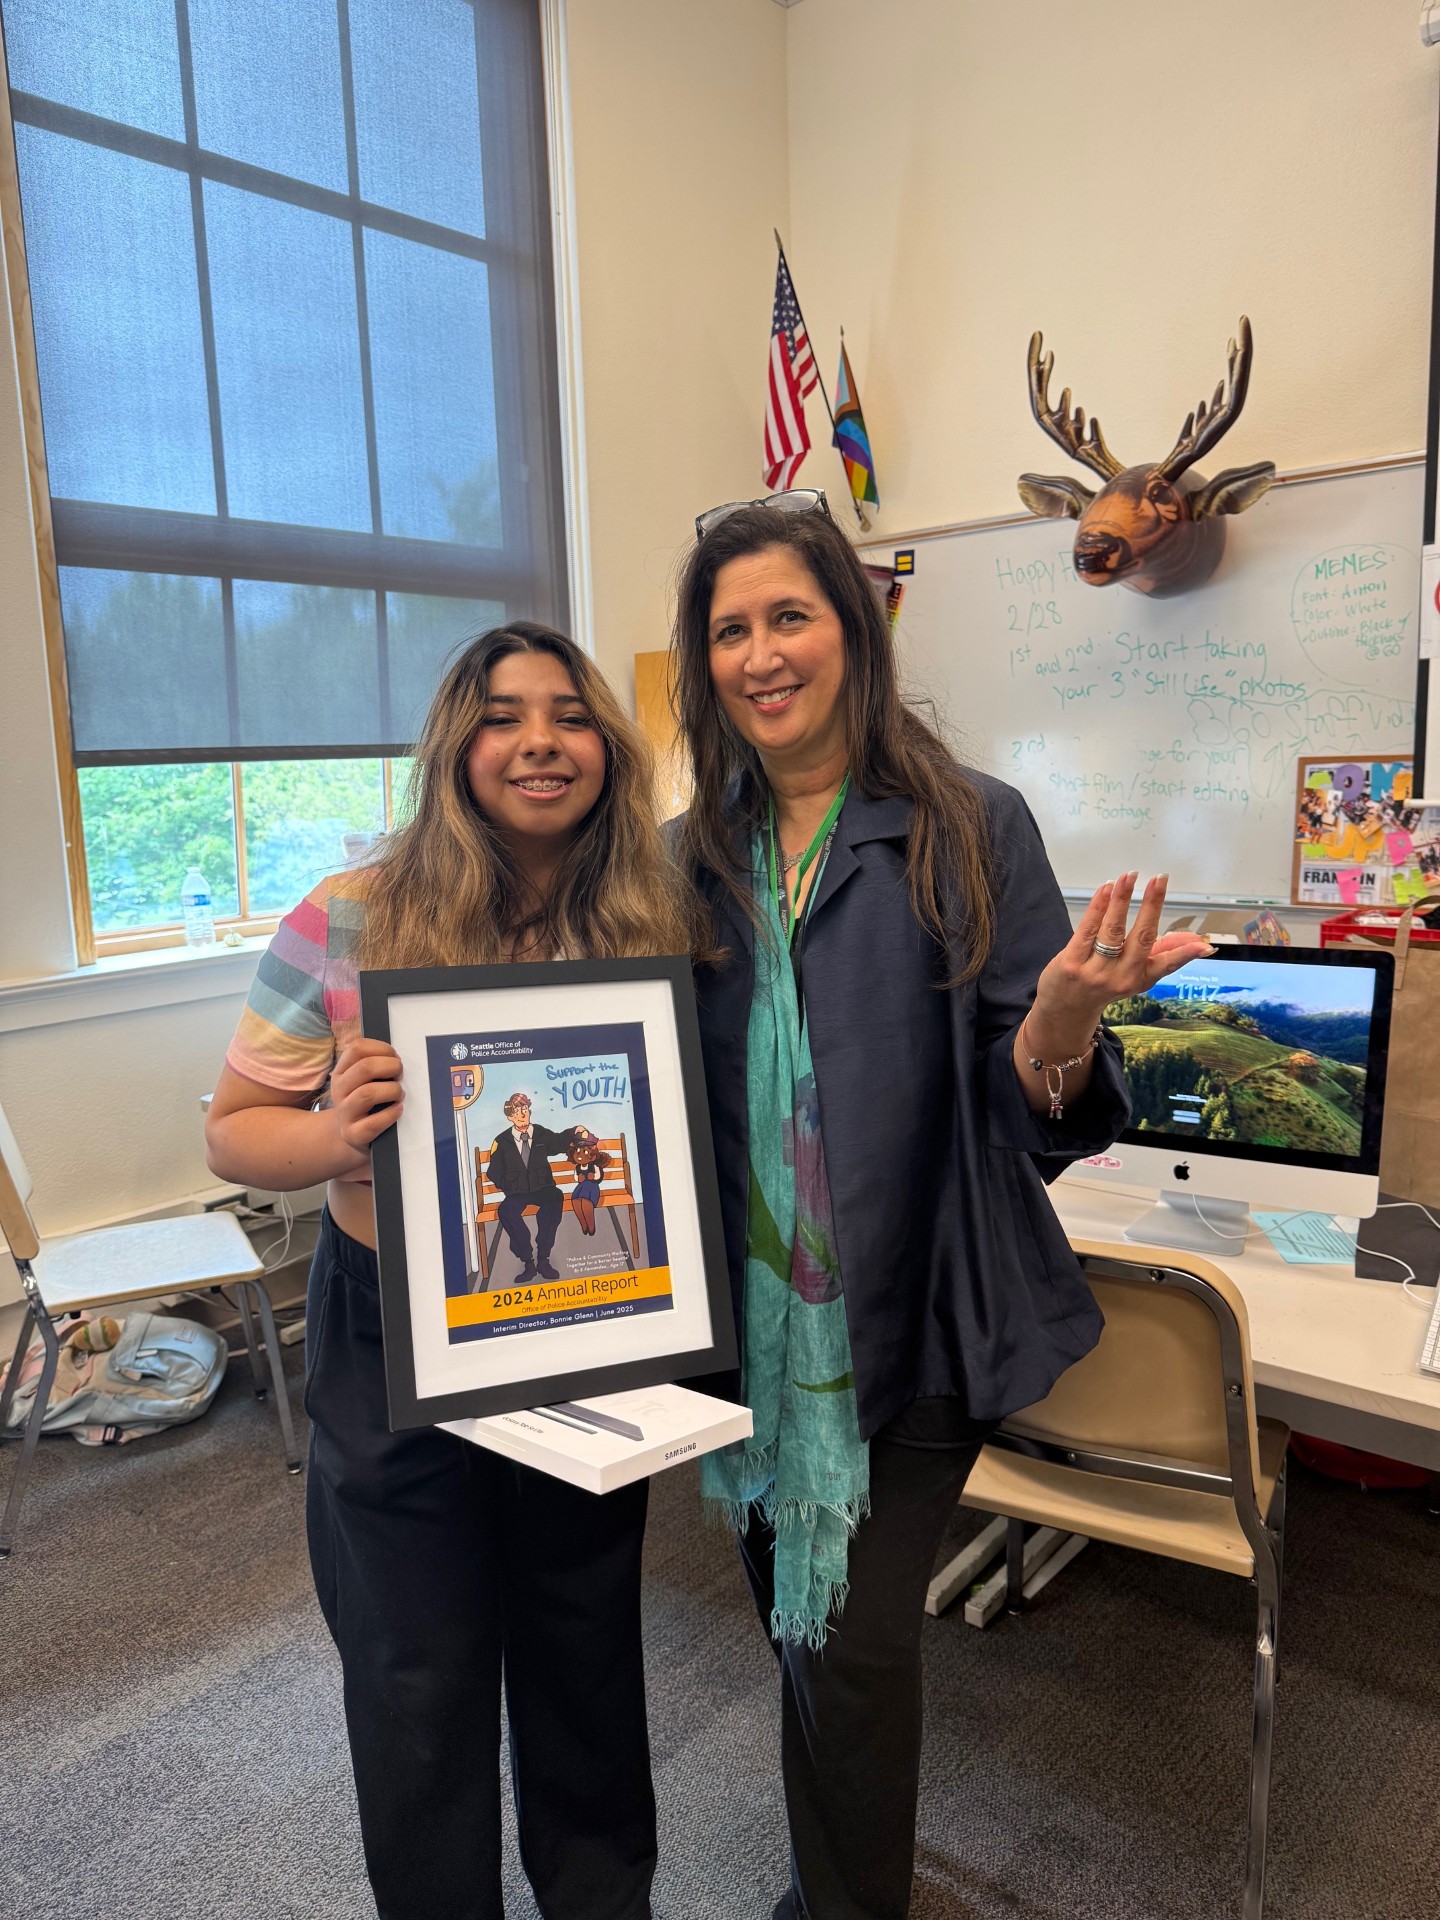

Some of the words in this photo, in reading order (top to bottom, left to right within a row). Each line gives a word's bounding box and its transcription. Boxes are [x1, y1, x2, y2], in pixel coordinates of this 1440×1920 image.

[995, 558, 1055, 594] Happy
[1007, 601, 1063, 635] 2/28
[1036, 656, 1061, 676] and
[1116, 632, 1188, 665] Start
[1194, 630, 1267, 682] taking
[1053, 684, 1099, 710] your
[1110, 671, 1126, 698] 3
[1093, 799, 1151, 829] footage
[1303, 871, 1376, 885] FRANIN
[1176, 983, 1220, 1001] 11:17
[491, 1047, 534, 1056] Accountability
[494, 1041, 513, 1049] Office
[598, 1062, 619, 1072] the
[552, 1075, 626, 1108] YOUTH
[493, 1290, 533, 1308] 2024
[537, 1280, 588, 1301] Annual
[591, 1274, 639, 1294] Report
[521, 1306, 539, 1314] Office
[547, 1301, 565, 1310] Police
[566, 1295, 607, 1306] Accountability
[493, 1321, 517, 1333] Interim
[519, 1319, 548, 1329] Director,
[550, 1314, 573, 1324] Bonnie
[574, 1312, 594, 1320] Glenn
[600, 1309, 615, 1317] June
[616, 1305, 634, 1314] 2025
[664, 1442, 697, 1461] SAMSUNG
